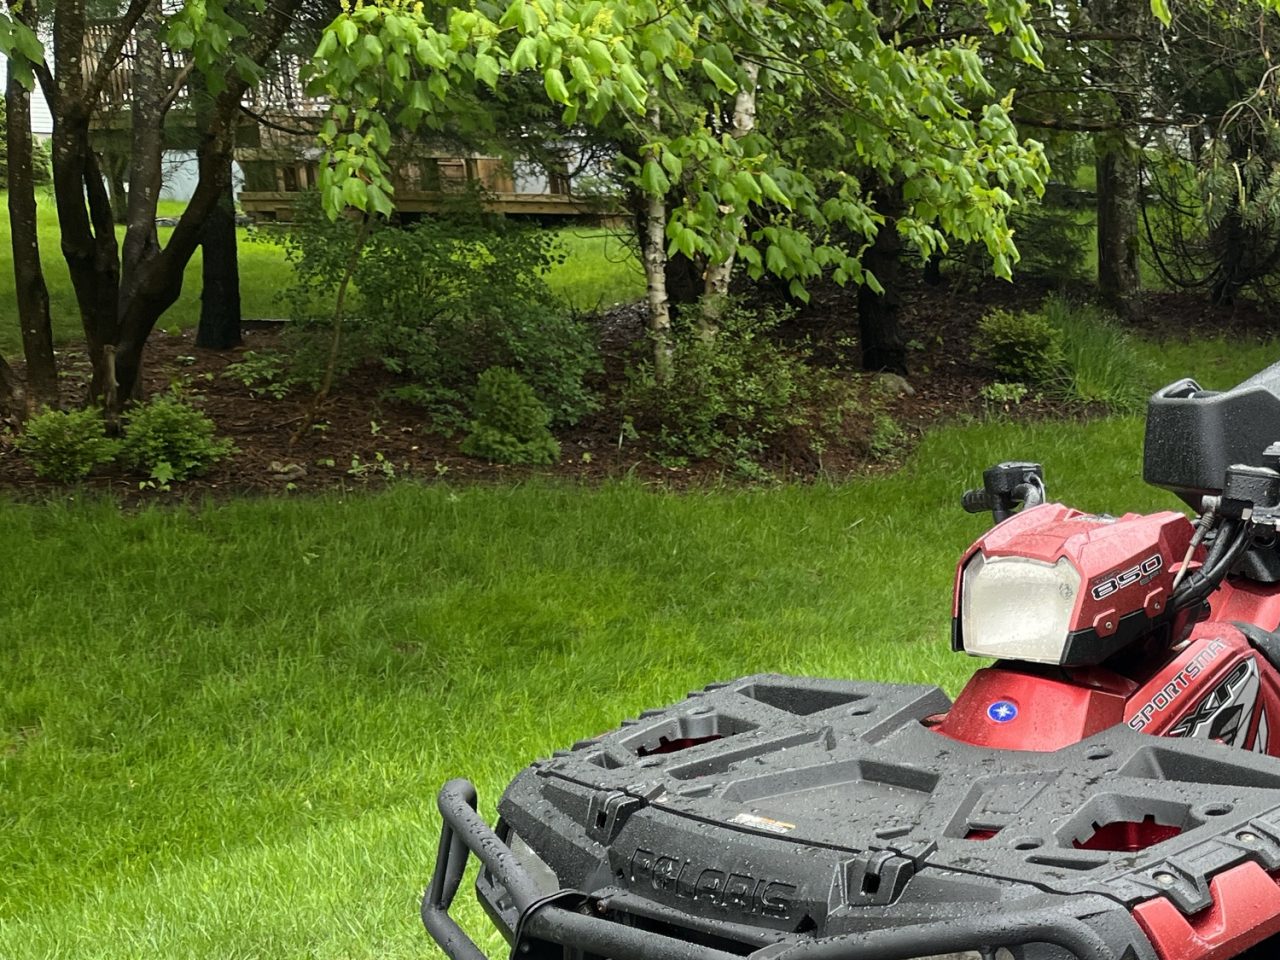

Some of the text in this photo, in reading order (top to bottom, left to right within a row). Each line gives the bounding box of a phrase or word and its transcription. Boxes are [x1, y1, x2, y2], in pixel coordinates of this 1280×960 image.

[1091, 553, 1163, 601] 850
[1128, 638, 1228, 732] SPORTSMA
[1167, 660, 1252, 737] XP
[630, 847, 798, 920] POLARIS
